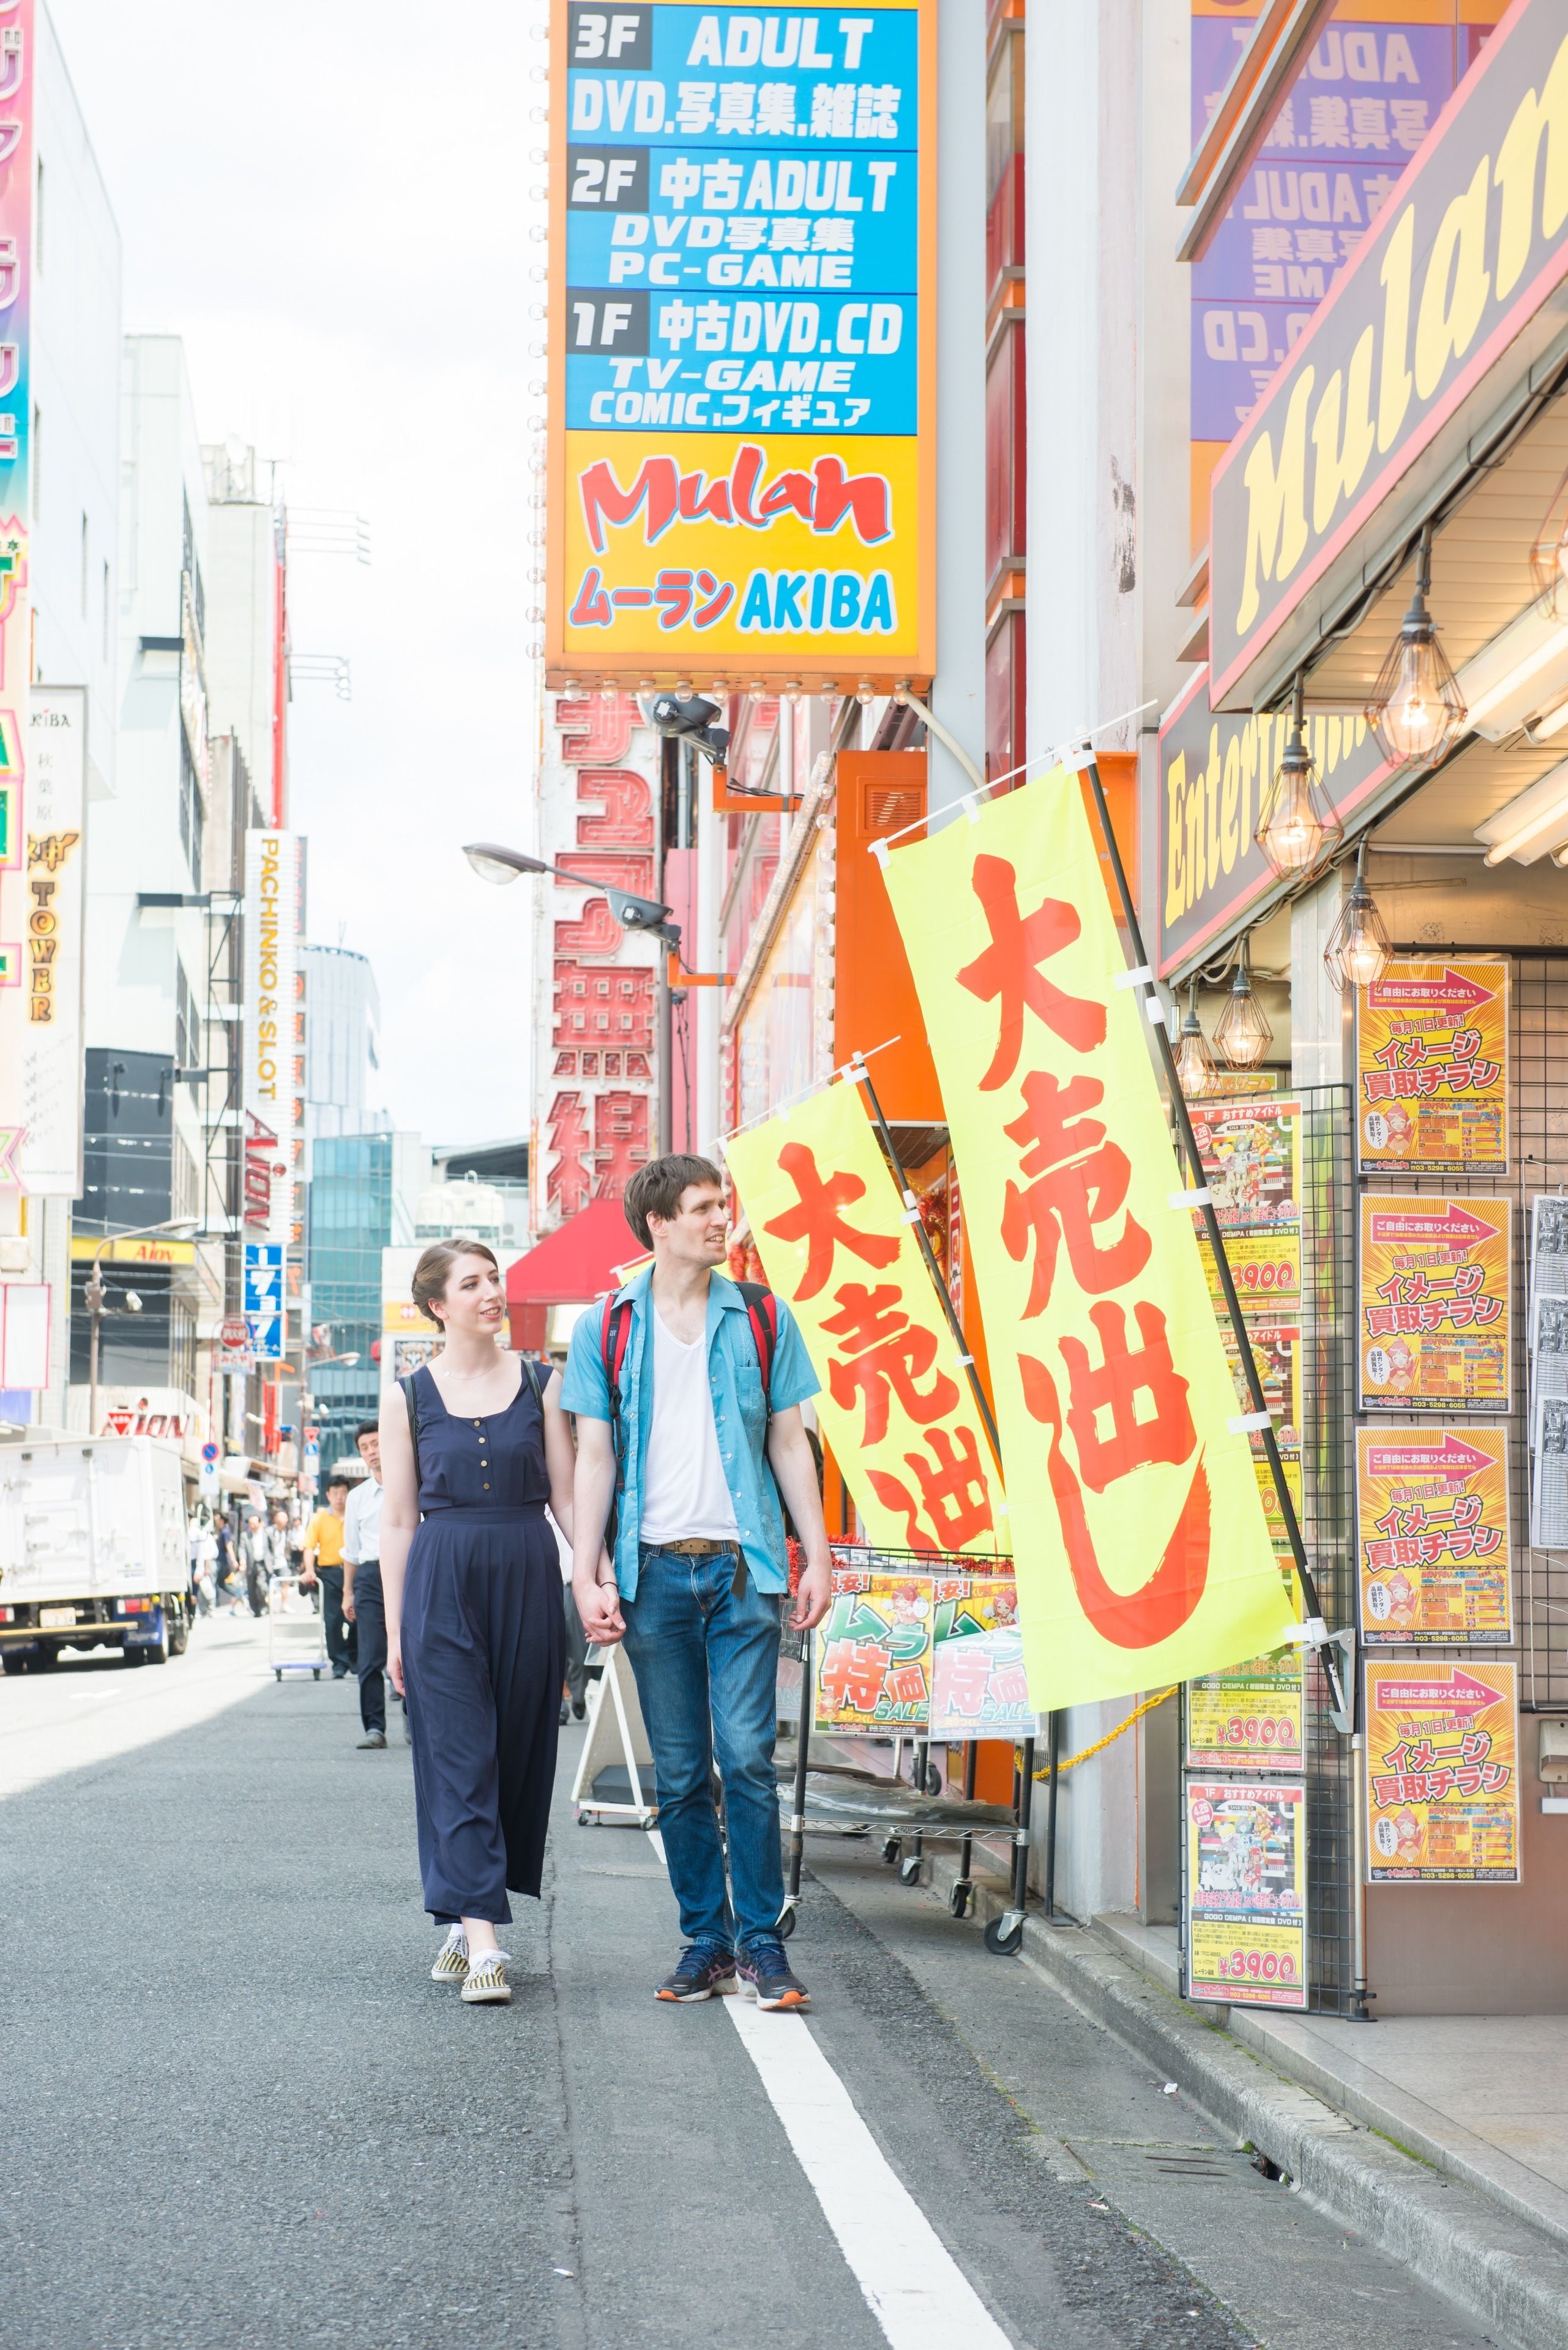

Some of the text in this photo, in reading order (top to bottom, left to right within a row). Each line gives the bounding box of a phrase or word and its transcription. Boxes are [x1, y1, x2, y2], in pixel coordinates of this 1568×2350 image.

[575, 15, 874, 69] 3F ADULT
[571, 158, 897, 212] 2F 中古ADULT
[611, 216, 855, 252] DVD写真集
[608, 252, 854, 287] PC-GAME
[573, 299, 903, 354] 1F 中古DVD.CD
[608, 357, 856, 393] TV-GAME
[578, 442, 895, 555] Mulan
[569, 567, 898, 635] ムーラン AKIBA
[29, 880, 58, 1024] TOWER
[258, 838, 279, 1100] PACHINKO & SLOT
[1373, 1028, 1483, 1070] イメージ
[1363, 1058, 1501, 1103] 買取チラシ
[1204, 1111, 1215, 1121] 1F
[1376, 1264, 1486, 1305] イメージ
[1365, 1294, 1504, 1338] 買取チラシ
[1375, 1495, 1484, 1538] イメージ
[1365, 1525, 1503, 1573] 買取チラシ
[819, 1636, 930, 1712] 特価
[873, 1701, 930, 1721] SALE
[1217, 1715, 1294, 1747] ¥3900
[1382, 1731, 1492, 1774] イメージ
[1205, 1788, 1216, 1797] 1F
[1372, 1761, 1511, 1809] 買取チラシ
[1219, 1949, 1296, 1982] ¥3900
